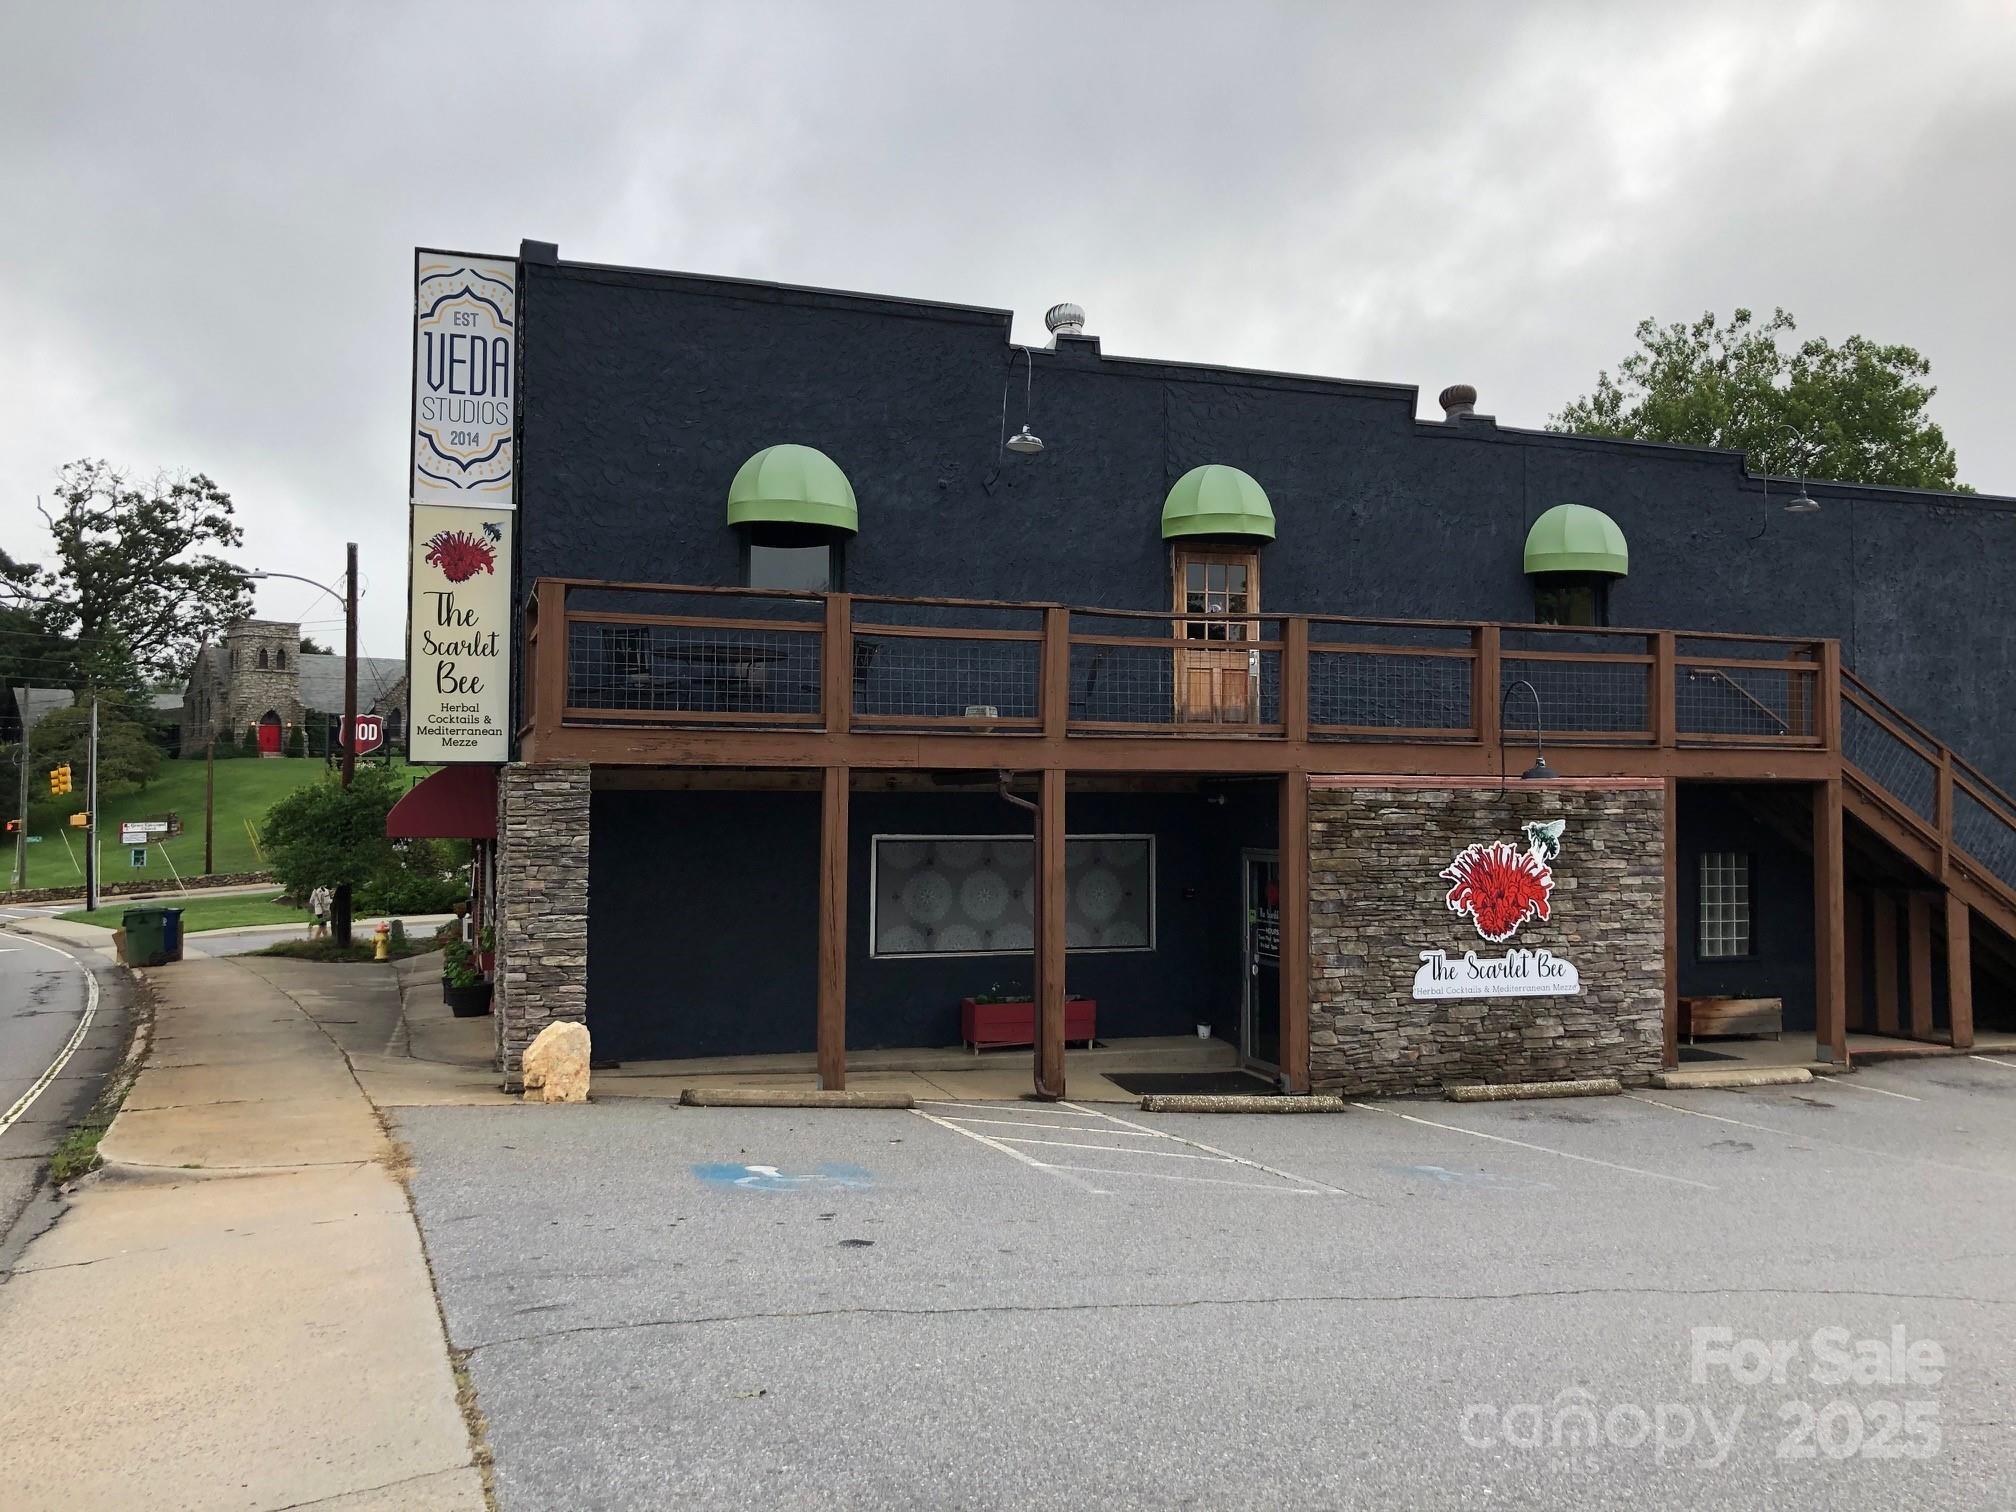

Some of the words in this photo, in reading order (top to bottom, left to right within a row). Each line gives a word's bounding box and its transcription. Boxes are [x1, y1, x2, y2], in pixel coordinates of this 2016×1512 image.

[453, 311, 479, 327] EST
[423, 331, 510, 398] VEDA
[422, 396, 509, 425] STUDIOS
[450, 431, 480, 447] 2014
[423, 591, 480, 627] The
[422, 630, 500, 658] Scarlet
[436, 660, 485, 694] Bee
[440, 702, 480, 713] Herbal
[427, 714, 480, 724] Cocktails
[483, 714, 492, 724] &
[355, 723, 378, 741] OD
[416, 726, 503, 736] Mediterranean
[441, 737, 478, 747] Mezze
[1423, 953, 1459, 981] The
[1467, 953, 1530, 980] Scarlet
[1538, 952, 1567, 978] Bee
[1416, 986, 1444, 996] Herbal
[1446, 986, 1482, 995] Cocktails
[1483, 985, 1490, 993] &
[1492, 984, 1551, 994] Mediterranean
[1553, 983, 1577, 992] Mezze
